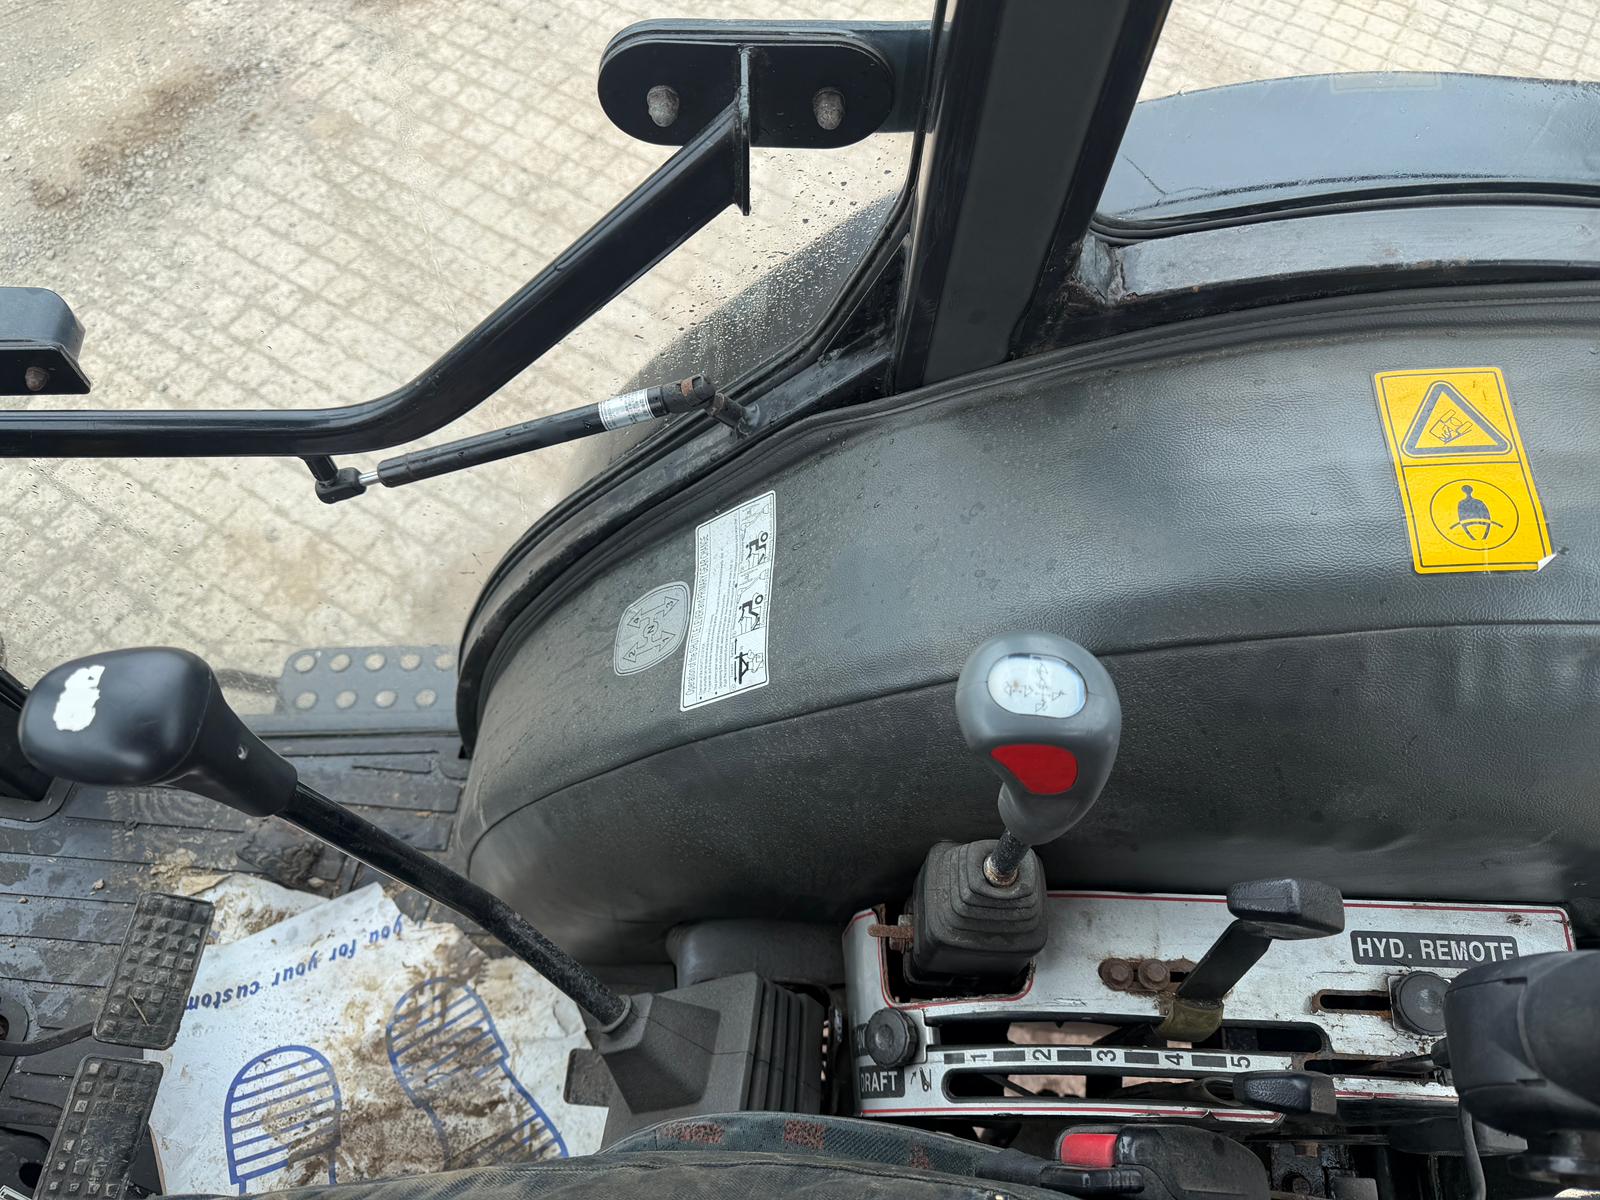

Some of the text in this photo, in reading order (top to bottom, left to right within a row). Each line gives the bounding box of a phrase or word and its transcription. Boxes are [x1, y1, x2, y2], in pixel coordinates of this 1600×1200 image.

[693, 611, 702, 627] LEVER
[691, 627, 700, 652] SHUTTLE
[686, 669, 697, 696] Operation
[1357, 936, 1514, 962] HYD. REMOTE
[184, 914, 403, 1012] you for your custom
[971, 1048, 1251, 1069] 1 2 3 4 5
[860, 1070, 898, 1092] DRAFT
